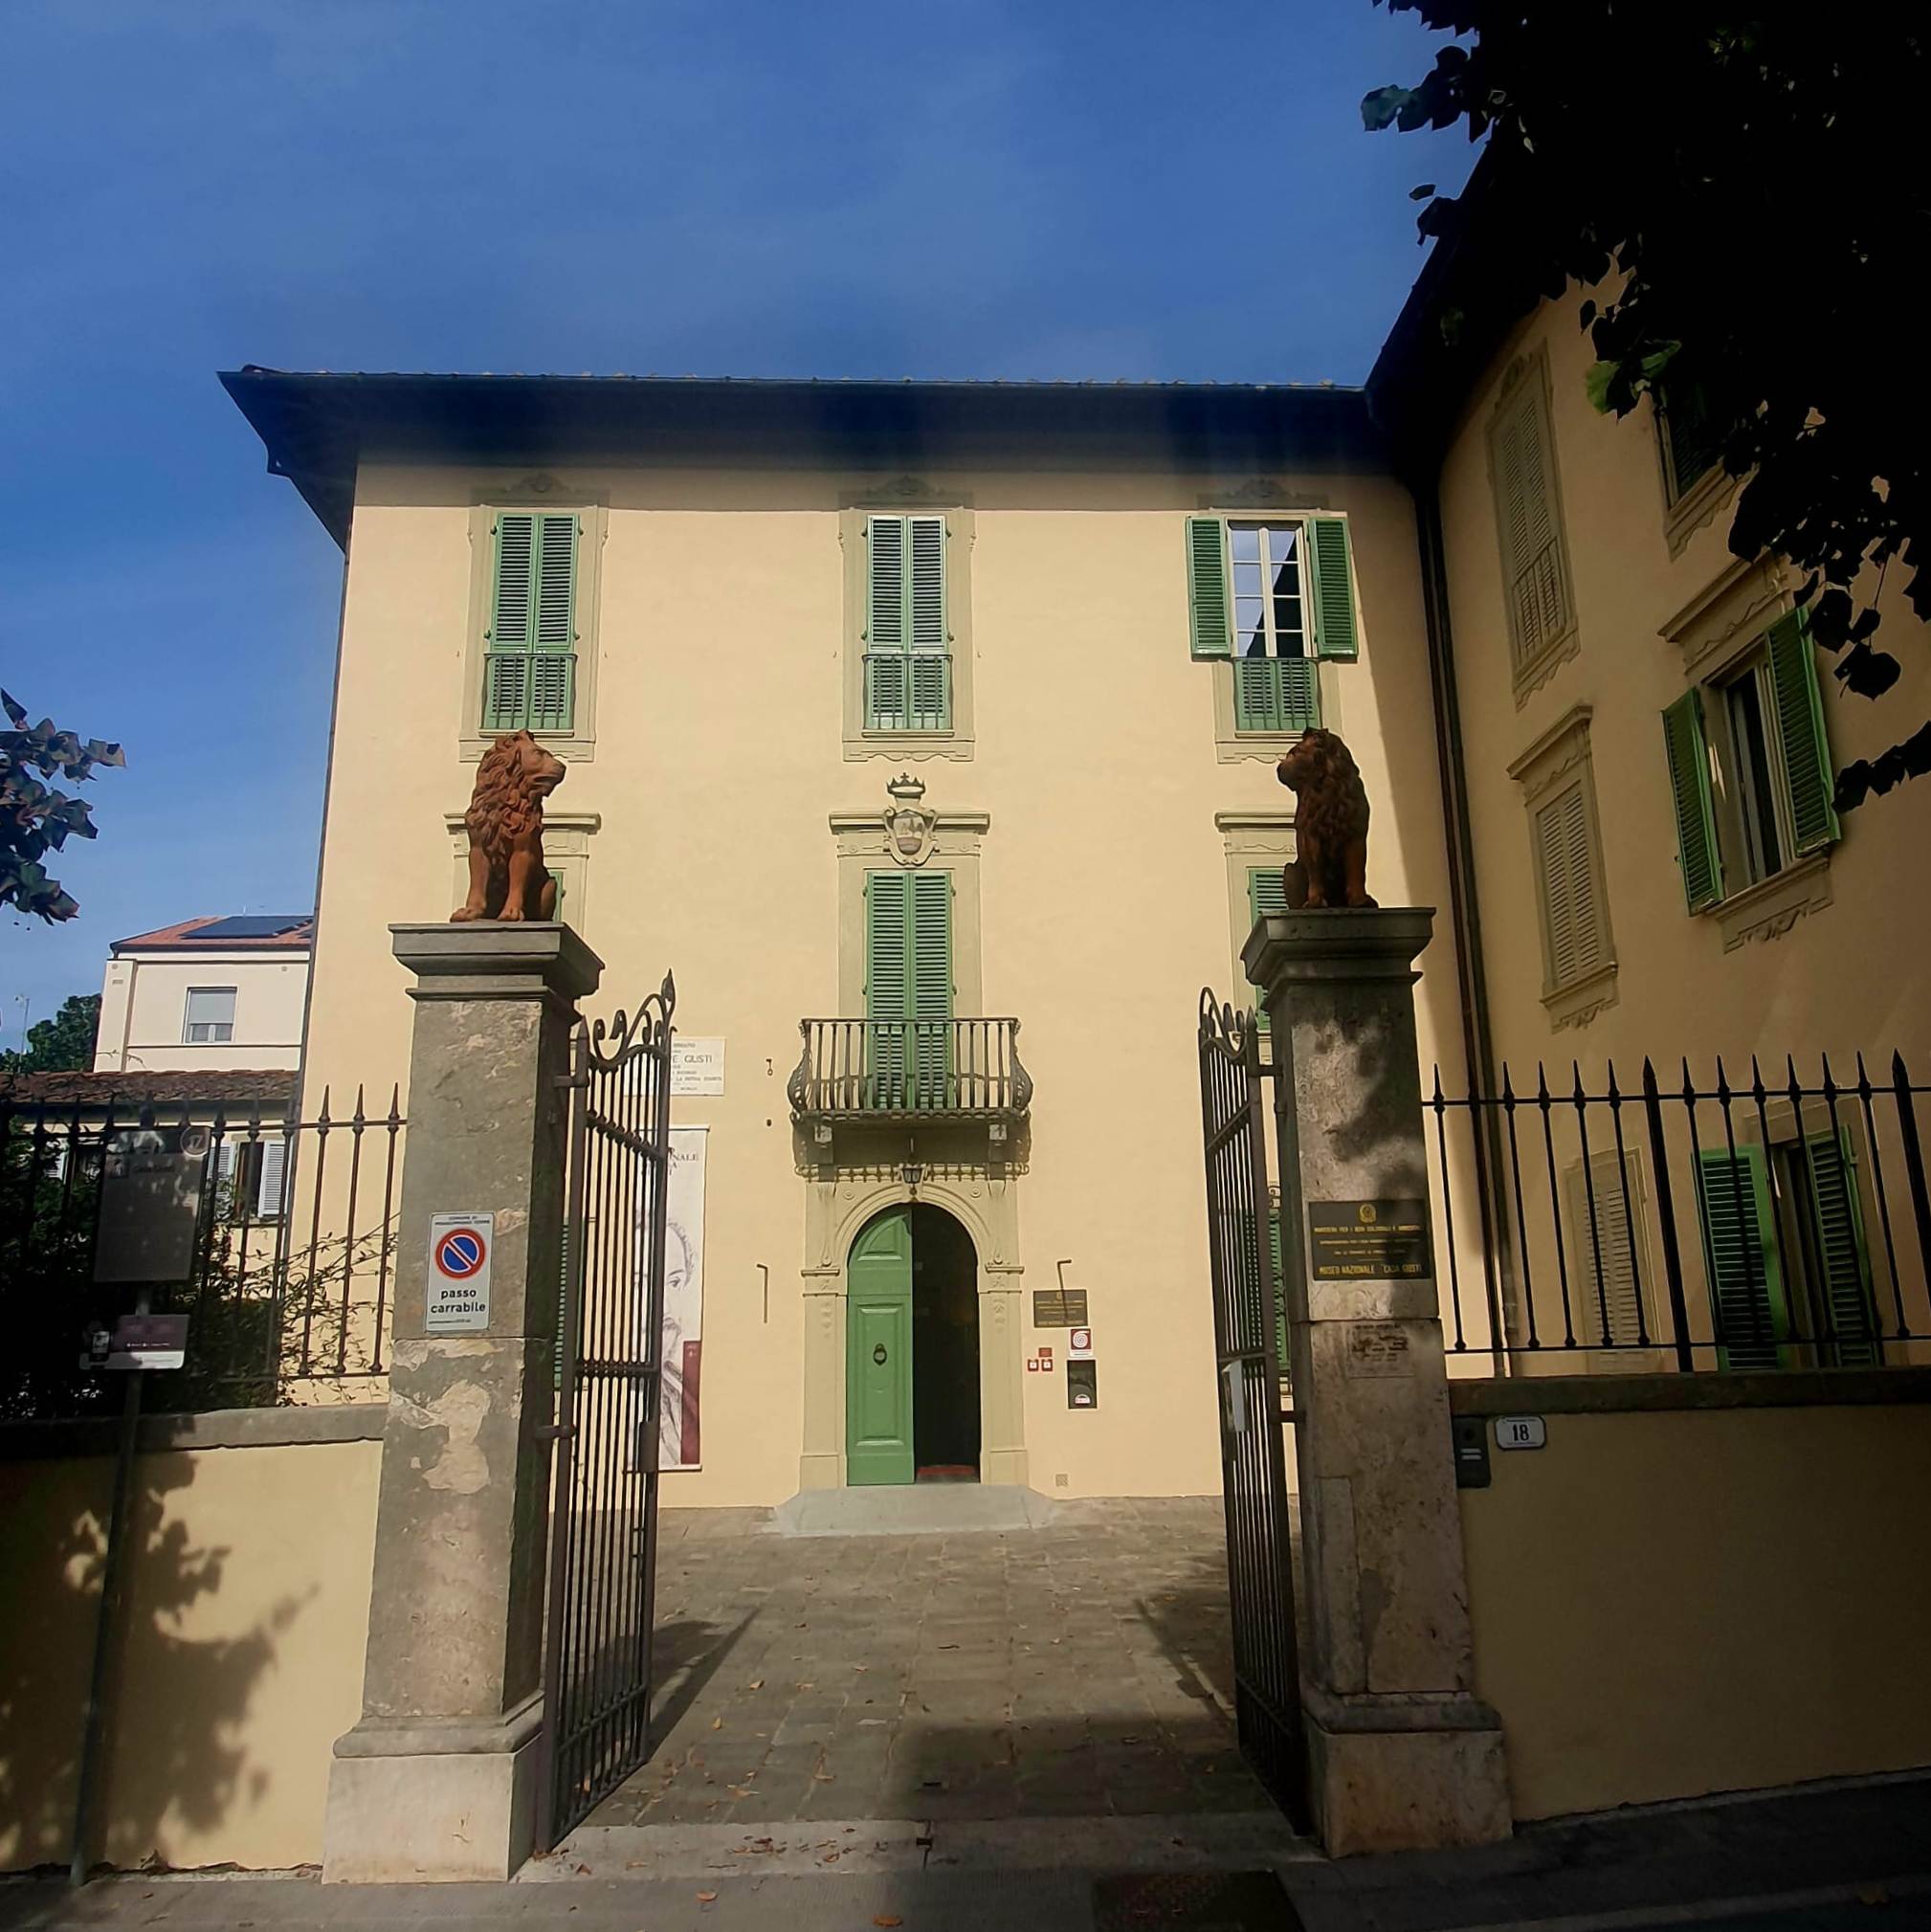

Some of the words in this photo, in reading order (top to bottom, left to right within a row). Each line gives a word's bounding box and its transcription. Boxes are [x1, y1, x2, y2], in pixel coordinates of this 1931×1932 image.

[440, 1289, 477, 1300] passo
[431, 1301, 486, 1313] carrabile
[1512, 1424, 1529, 1441] 18
